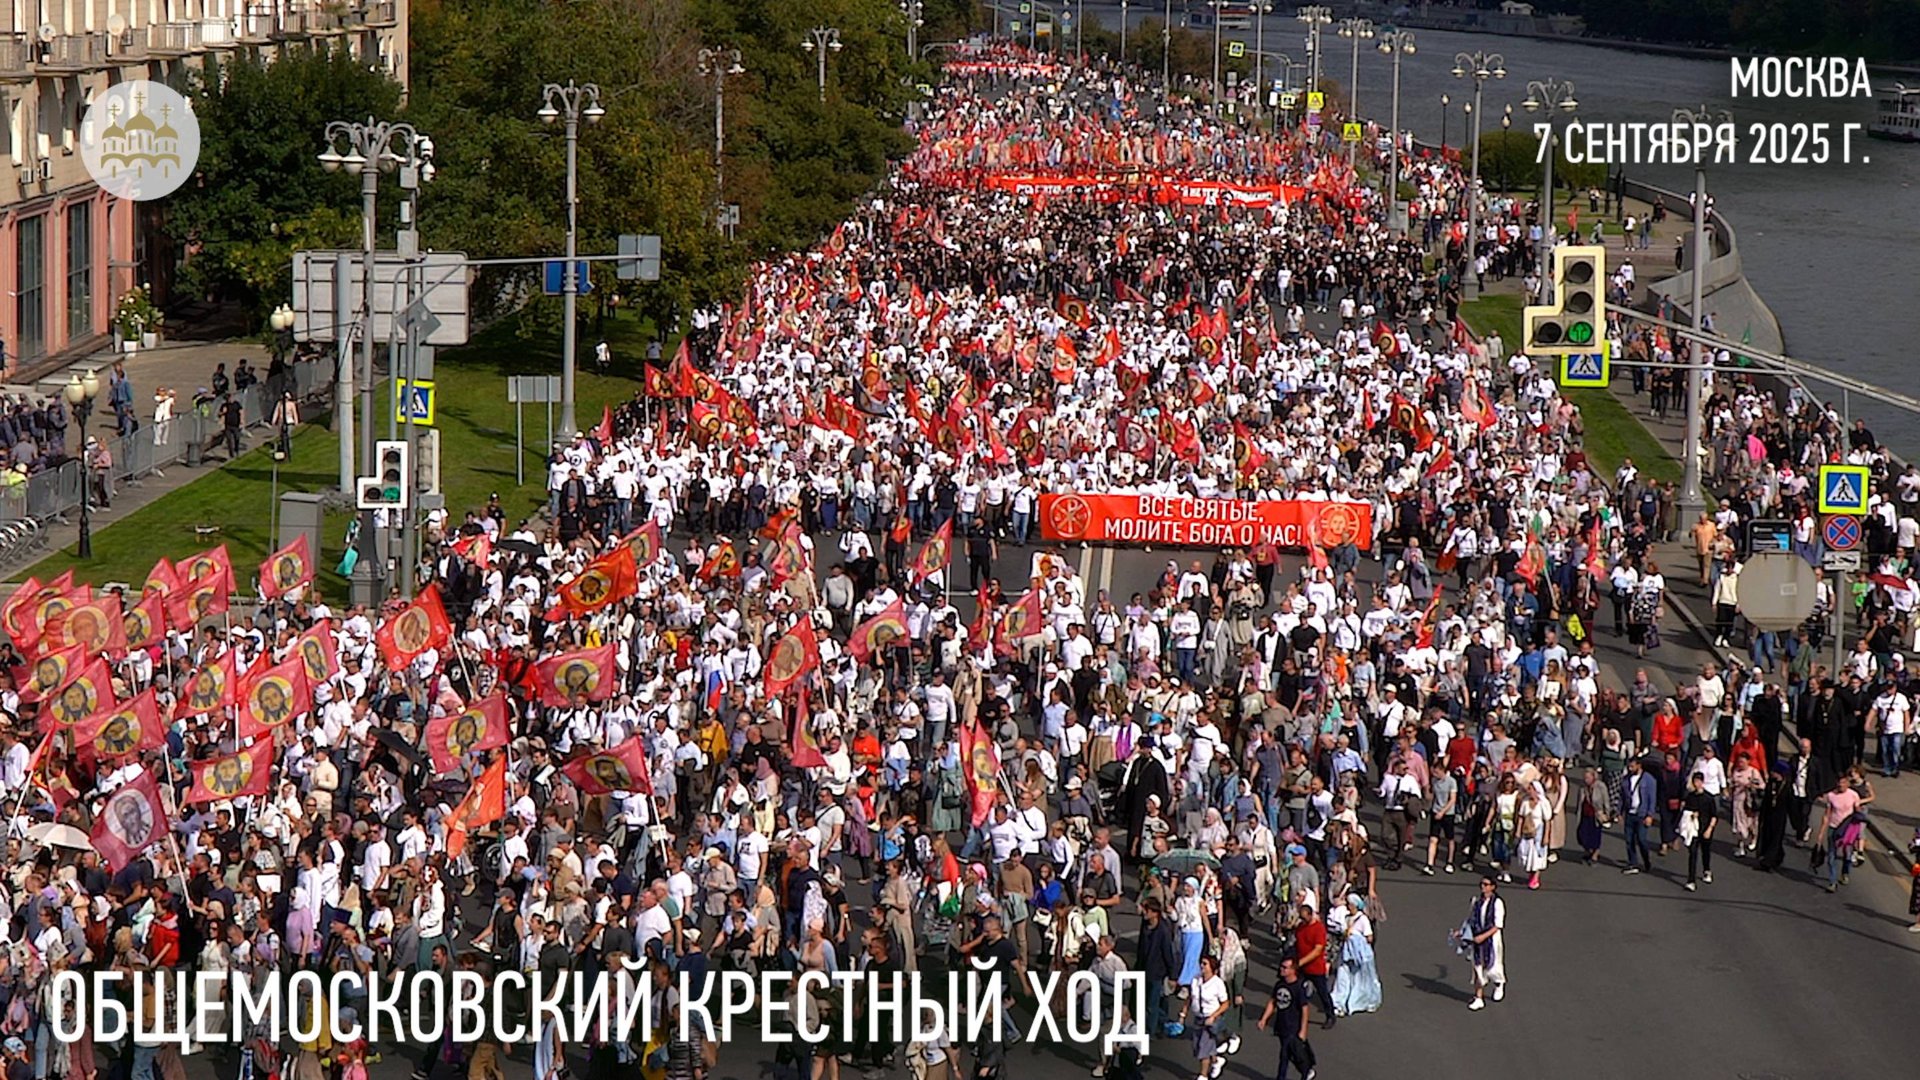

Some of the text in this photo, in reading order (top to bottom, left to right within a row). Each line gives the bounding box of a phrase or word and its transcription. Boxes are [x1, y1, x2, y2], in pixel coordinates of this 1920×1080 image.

[1138, 495, 1264, 523] ВСЕ СВЯТЫЕ,
[1104, 518, 1302, 545] МОЛИТЕ БОГА О НАС!
